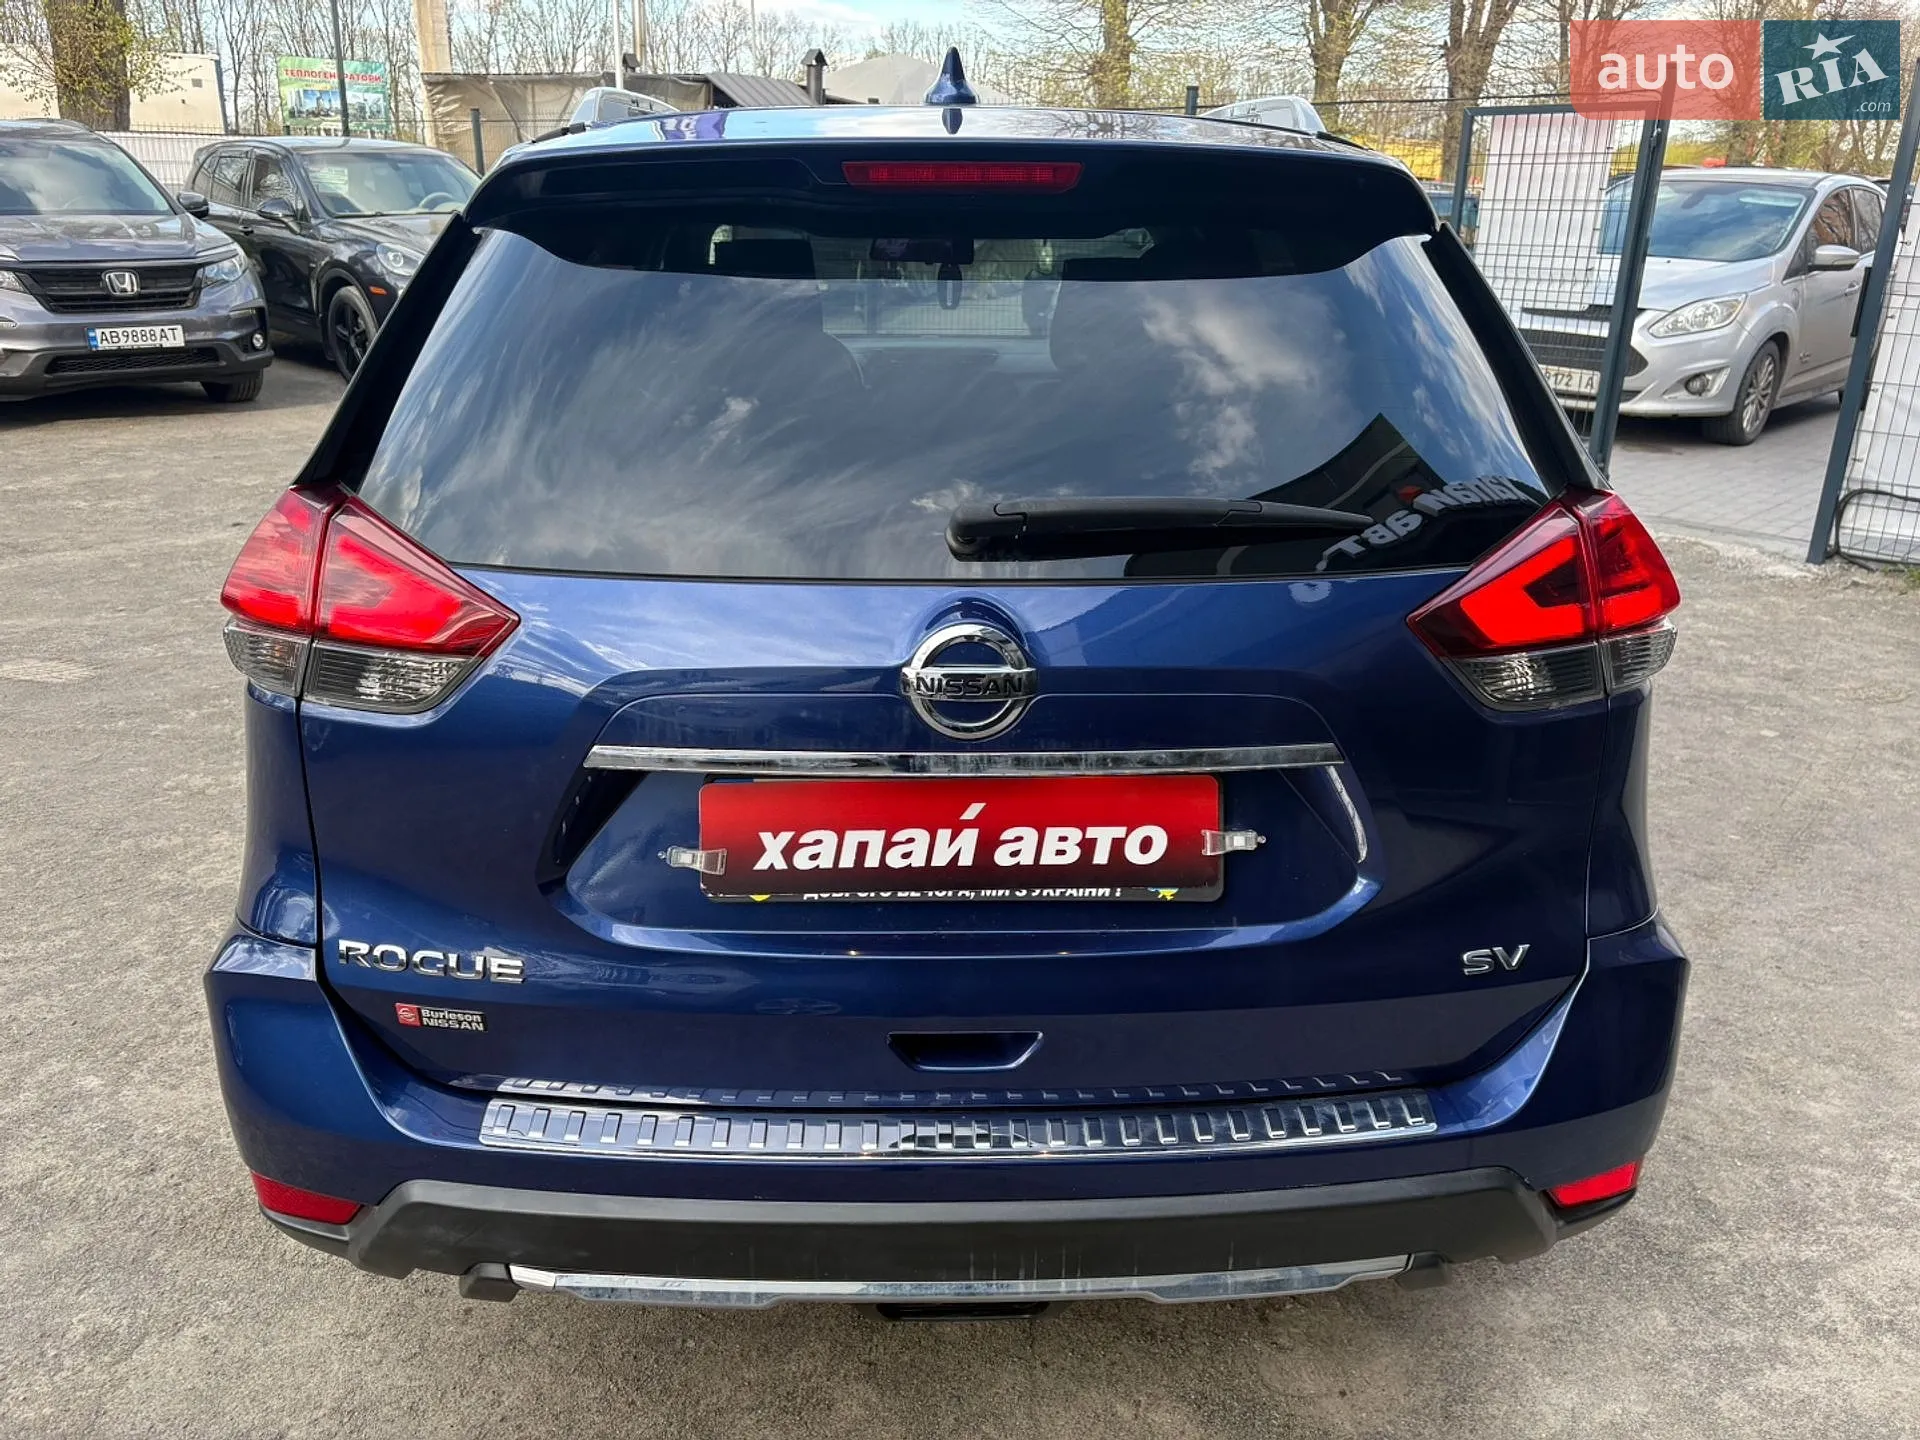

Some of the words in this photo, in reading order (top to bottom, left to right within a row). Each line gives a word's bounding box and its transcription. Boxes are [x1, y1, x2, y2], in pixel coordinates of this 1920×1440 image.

[284, 68, 383, 82] ТЕПЛОГЕНРАТОРИ
[100, 328, 177, 345] AB9888AT
[915, 676, 1023, 696] NISSAN
[993, 825, 1168, 867] авто
[338, 939, 526, 984] ROGUE
[1463, 944, 1530, 976] SV
[421, 1009, 482, 1022] Burleson
[422, 1017, 484, 1031] NISSAN
